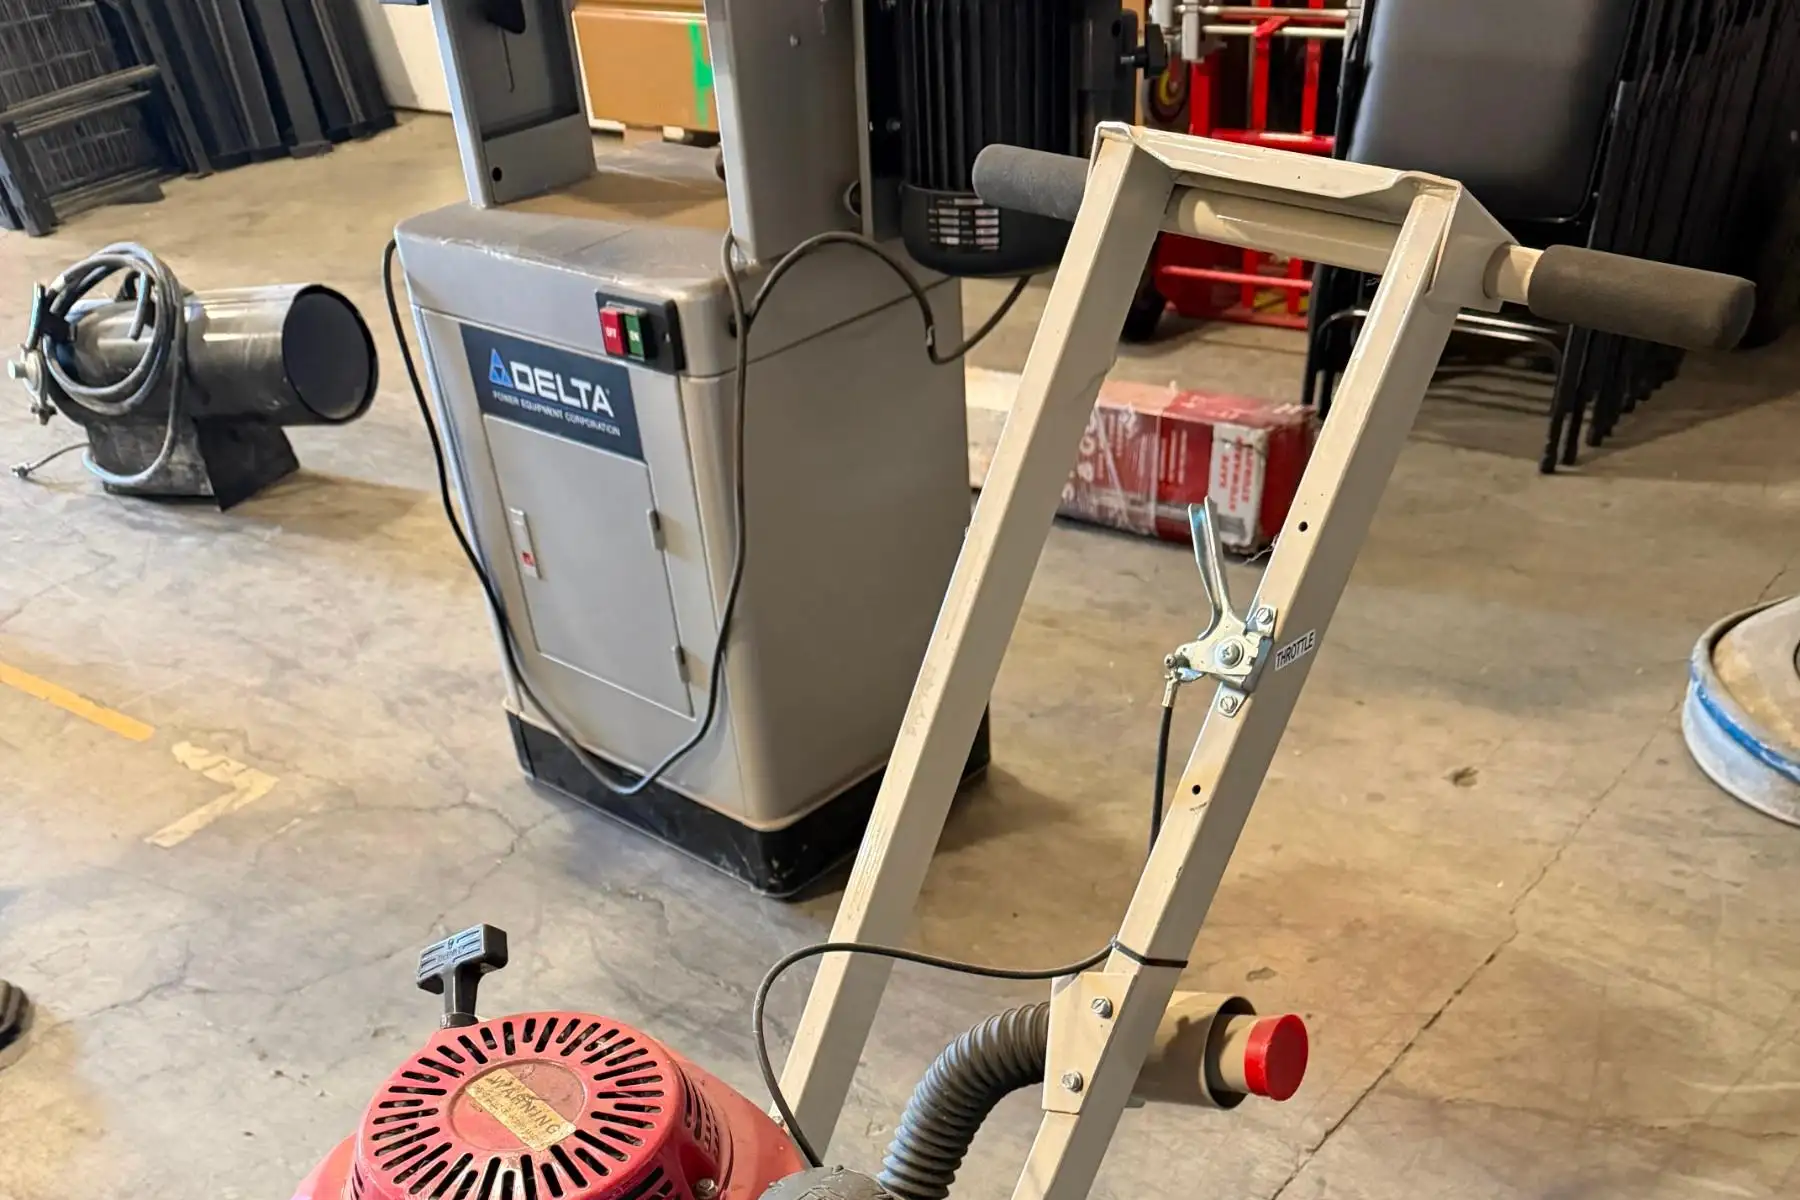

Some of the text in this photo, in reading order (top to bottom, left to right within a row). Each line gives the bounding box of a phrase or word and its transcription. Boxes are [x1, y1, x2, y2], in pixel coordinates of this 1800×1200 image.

[492, 390, 621, 437] POWER EQUIPMENT CORPORATION
[510, 361, 614, 418] DELTA
[1276, 632, 1315, 668] THROTTLE
[490, 1075, 561, 1134] WARNING
